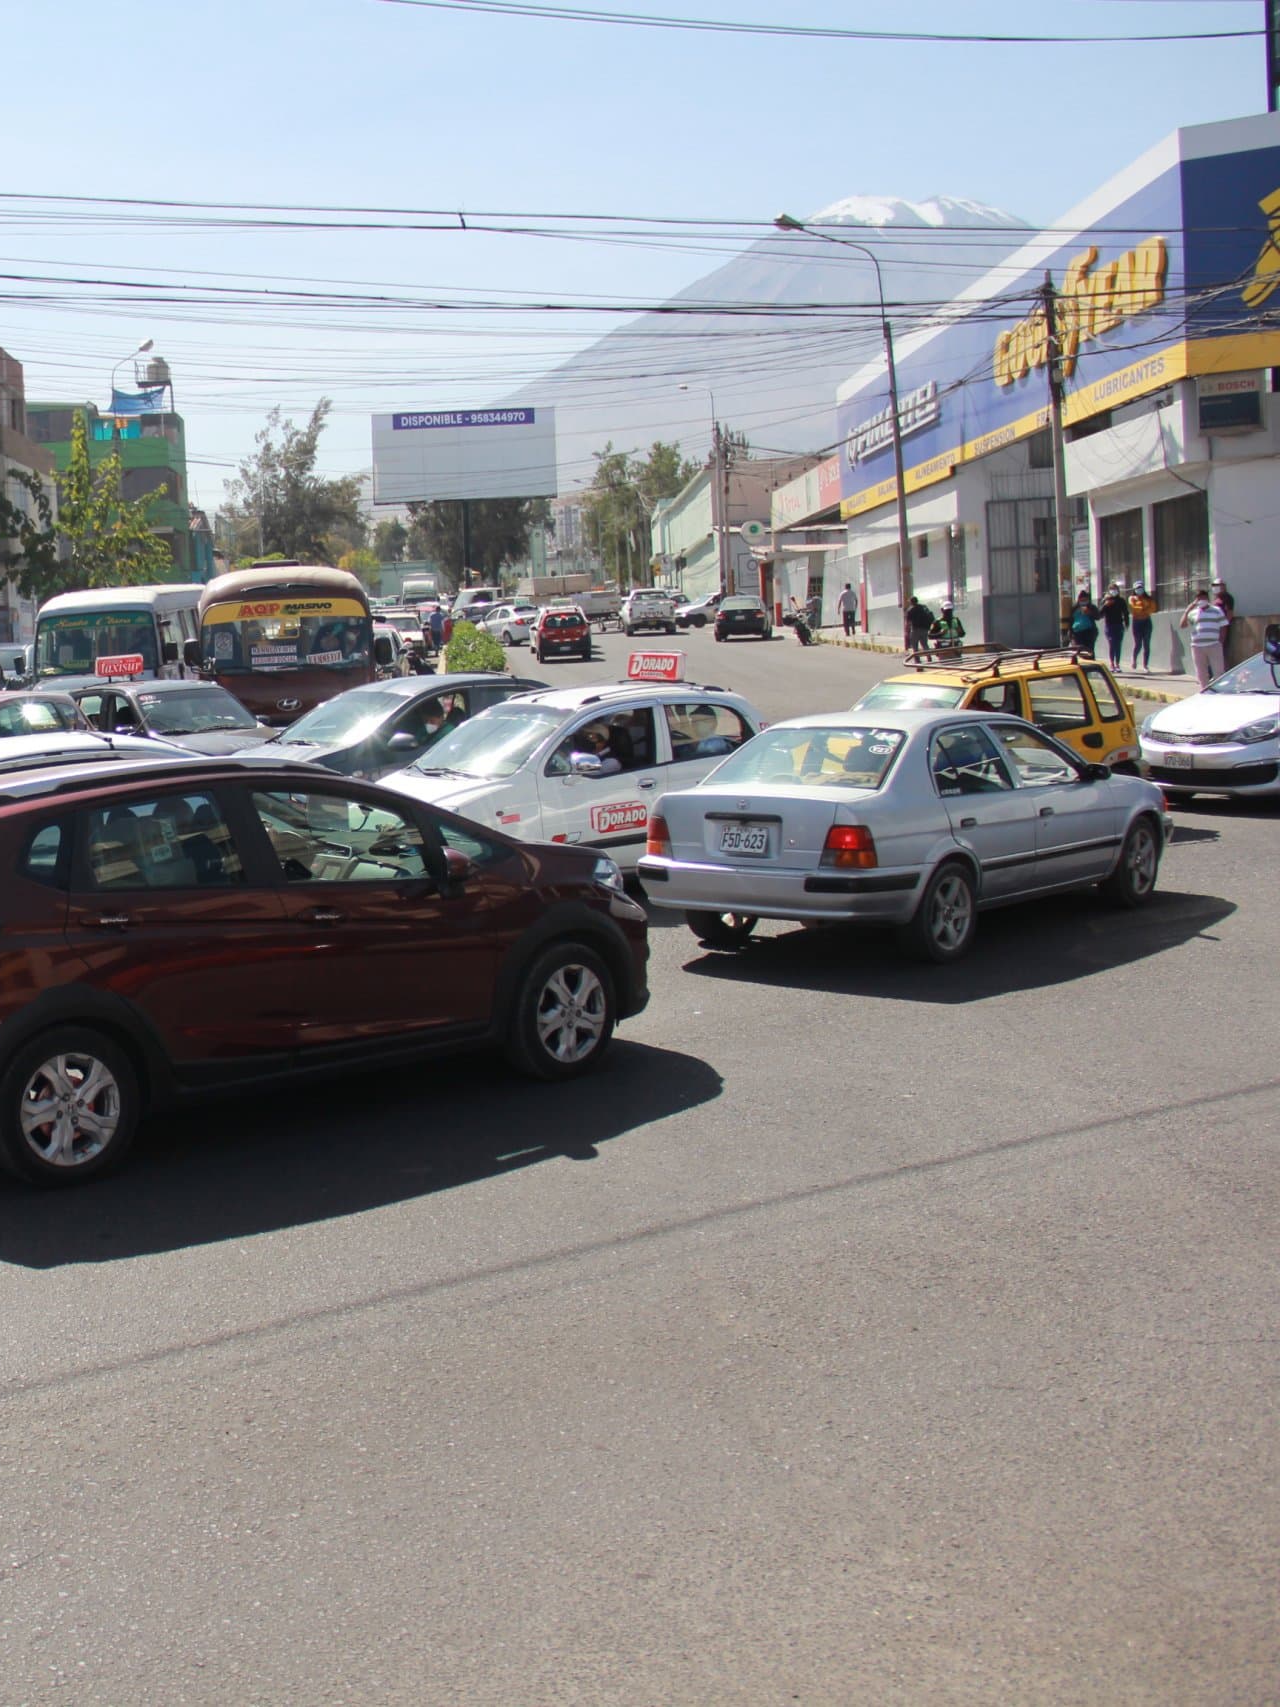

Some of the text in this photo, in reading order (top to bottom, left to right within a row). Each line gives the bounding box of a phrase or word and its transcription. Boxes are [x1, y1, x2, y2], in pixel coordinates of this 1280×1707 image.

[1036, 403, 1068, 425] FRES
[1093, 356, 1166, 401] LUBRICANTES
[1217, 379, 1256, 393] BOSCH
[401, 413, 463, 427] DISPONIBLE
[471, 411, 526, 424] 958344970
[238, 602, 281, 617] AQP
[100, 660, 140, 675] taxisur
[630, 655, 675, 675] DORADO
[600, 808, 646, 830] DORADO
[722, 832, 765, 850] F5D-623
